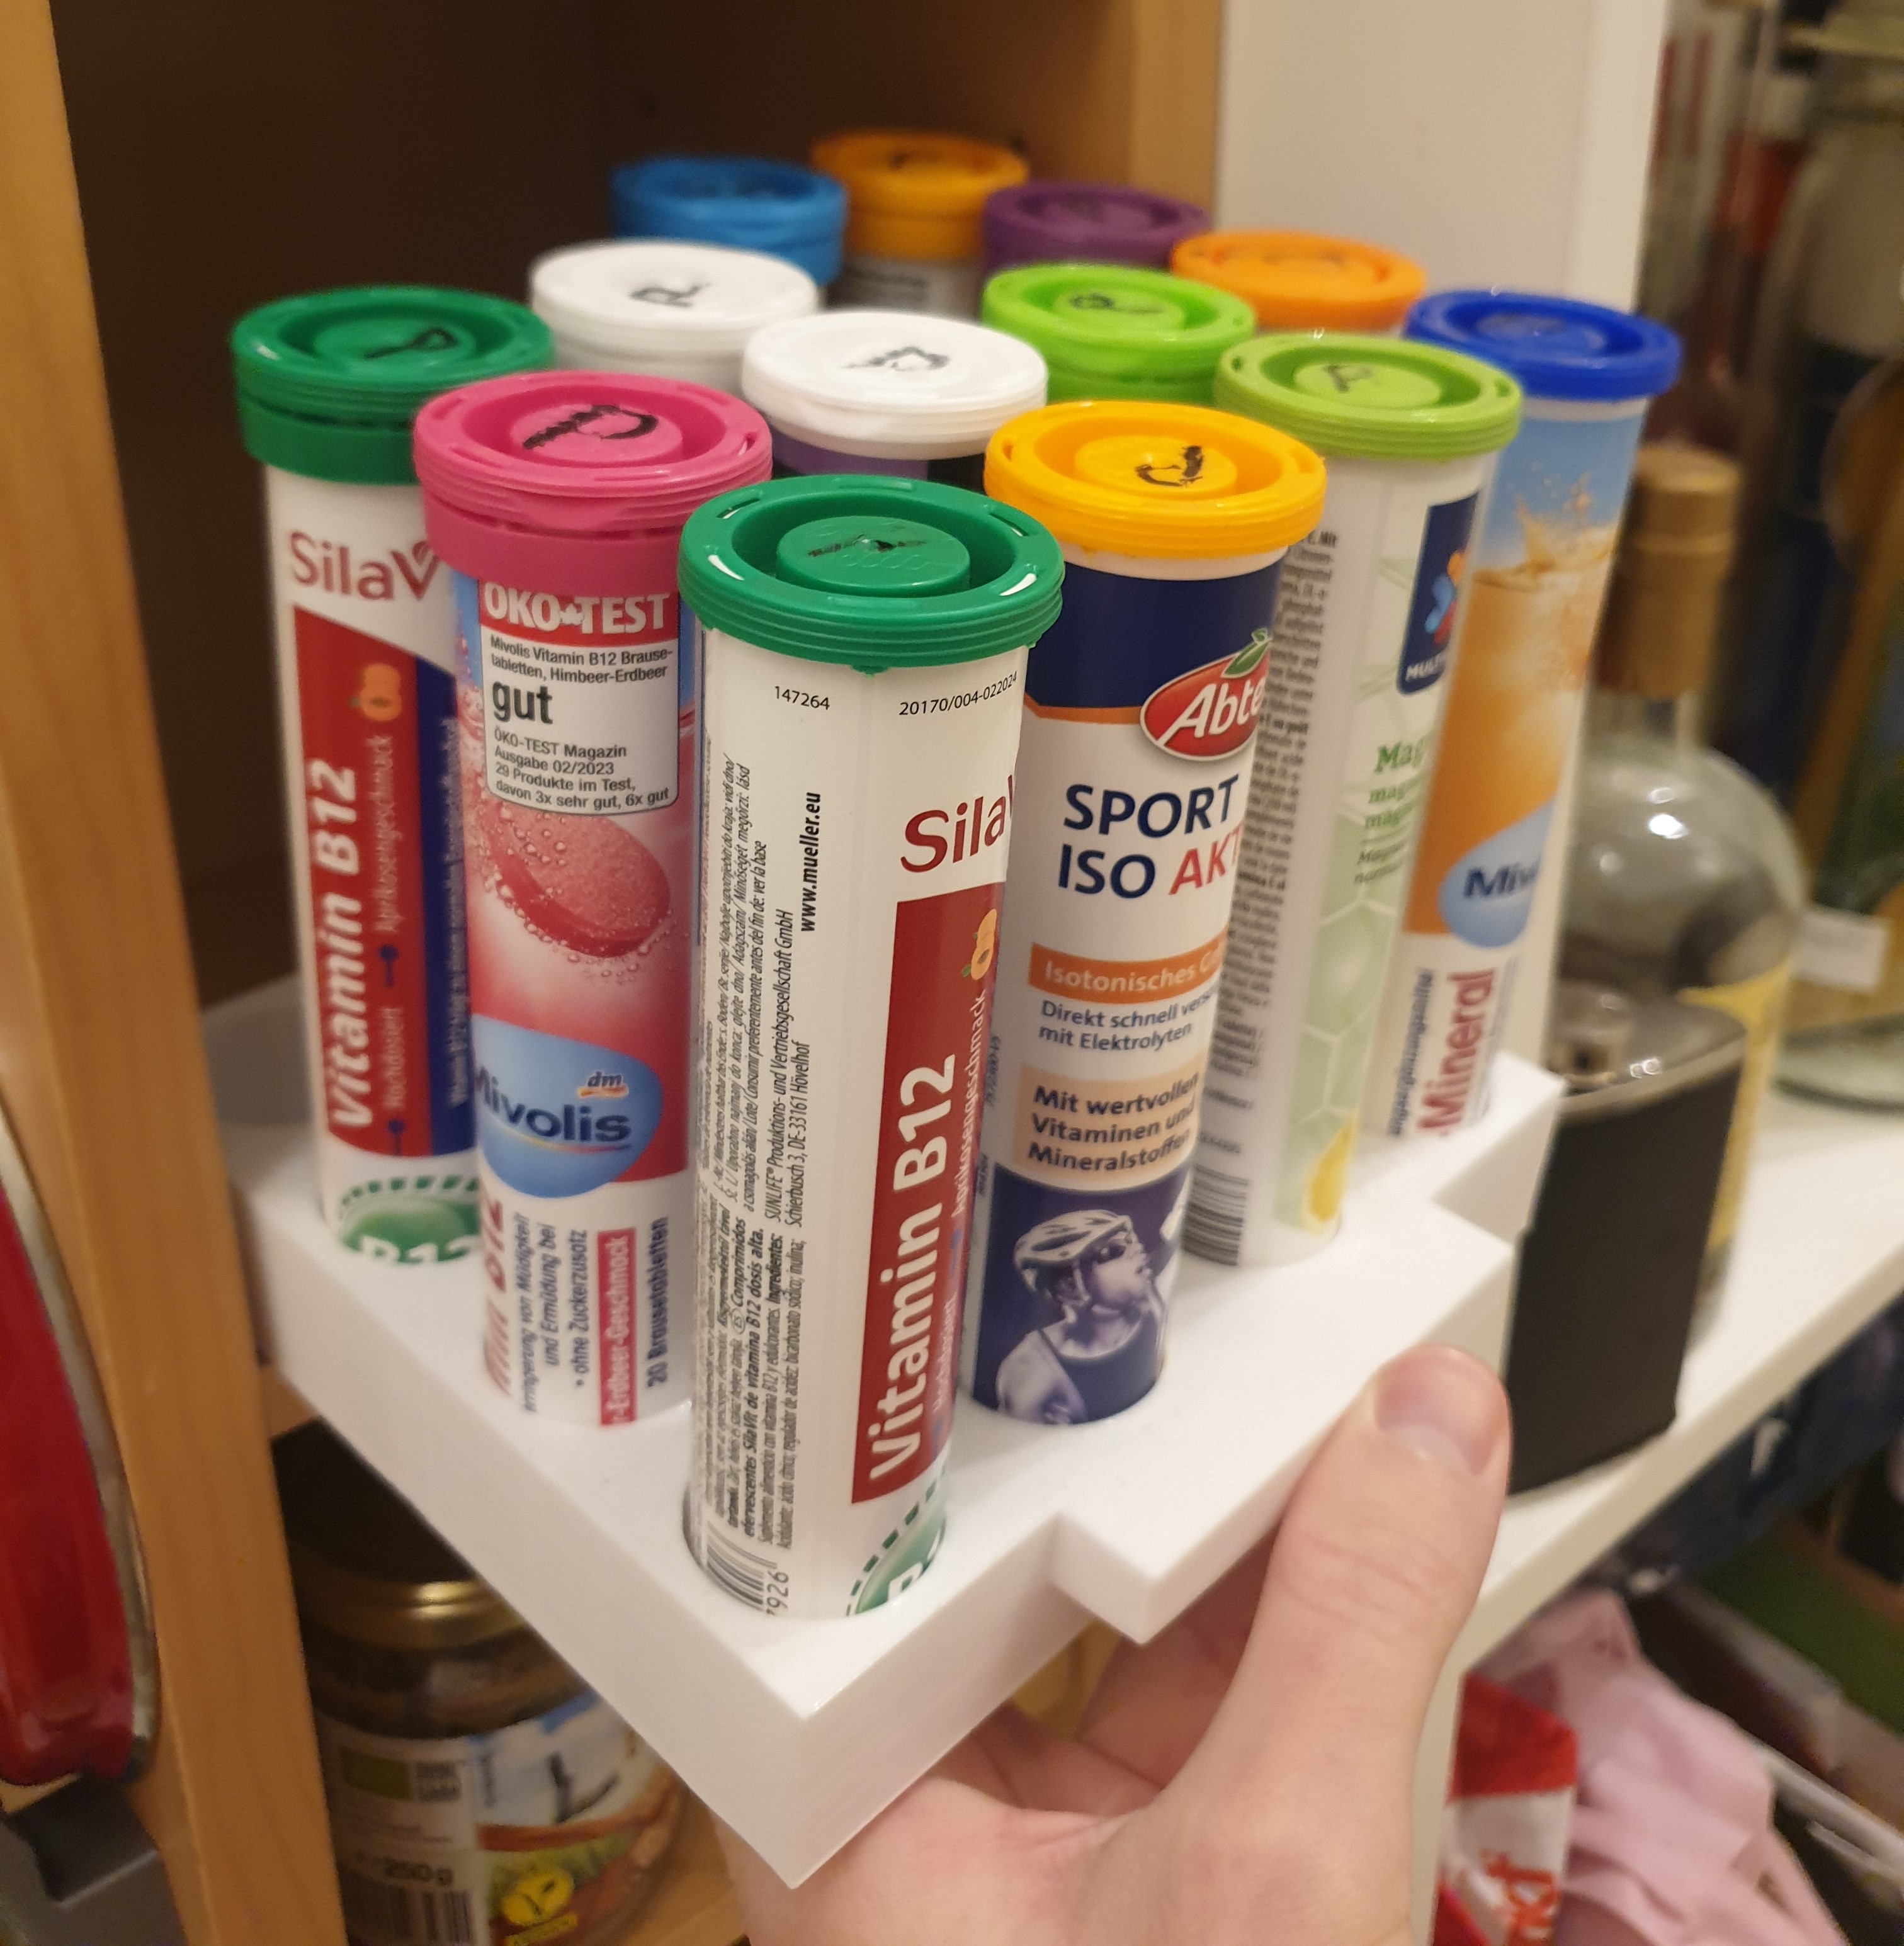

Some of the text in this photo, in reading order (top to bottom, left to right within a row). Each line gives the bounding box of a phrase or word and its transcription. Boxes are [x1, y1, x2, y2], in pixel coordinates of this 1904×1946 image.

[490, 634, 673, 666] Mivolis Vitamin B12 Brause-
[490, 653, 668, 684] tabletten, Himbeer-Erdbeer
[492, 681, 553, 724] gut
[774, 685, 830, 711] 147264
[899, 671, 1018, 715] 20170/004-022024
[494, 725, 627, 761] ÖKO-TEST Magazin
[495, 745, 615, 775] Ausgabe 02/2023
[735, 763, 750, 790] lásd
[496, 761, 636, 793] 29 Produkte im Test,
[496, 779, 670, 812] davon 3x sehr gut, 6x gut
[1063, 774, 1239, 838] SPORT
[722, 833, 733, 849] do
[750, 840, 767, 867] base
[750, 866, 766, 878] la
[799, 791, 821, 932] www.mueller.eu
[1058, 844, 1156, 899] ISO
[753, 876, 766, 894] ver
[748, 912, 764, 929] fin
[749, 895, 765, 913] de:
[309, 759, 373, 1128] Vitamin B12
[748, 926, 764, 946] del
[774, 908, 795, 949] GmbH
[750, 946, 764, 975] antes
[1045, 961, 1196, 995] Isotonisches
[748, 973, 764, 1058] preferentemente
[771, 949, 795, 1070] Vertriebsgesellschaft
[1042, 999, 1104, 1027] Direkt
[1110, 1001, 1179, 1029] schnell
[729, 1029, 743, 1063] konca:
[1039, 1024, 1074, 1046] mit
[1080, 1021, 1193, 1052] Elektrolyten
[587, 1072, 623, 1087] dm
[728, 1064, 742, 1080] do
[770, 1071, 787, 1095] und
[949, 989, 986, 1218] Aprikosengeschmack
[1033, 1084, 1079, 1113] Mit
[1087, 1072, 1199, 1116] wertvollen
[766, 1097, 787, 1167] Produktions-
[785, 1039, 810, 1228] Schierbusch 3, DE-33161 Hövelhof
[893, 1054, 956, 1191] B12
[1031, 1112, 1160, 1144] Vitaminen
[747, 1228, 764, 1259] alta.
[730, 1217, 748, 1308] Comprimidos
[539, 1253, 562, 1334] Ermüdung
[747, 1262, 762, 1298] dosis
[567, 1229, 591, 1375] ohne Zuckerzusatz
[746, 1299, 761, 1328] B12
[542, 1335, 560, 1367] und
[868, 1202, 943, 1479] Vitamin
[766, 1571, 789, 1616] 926
